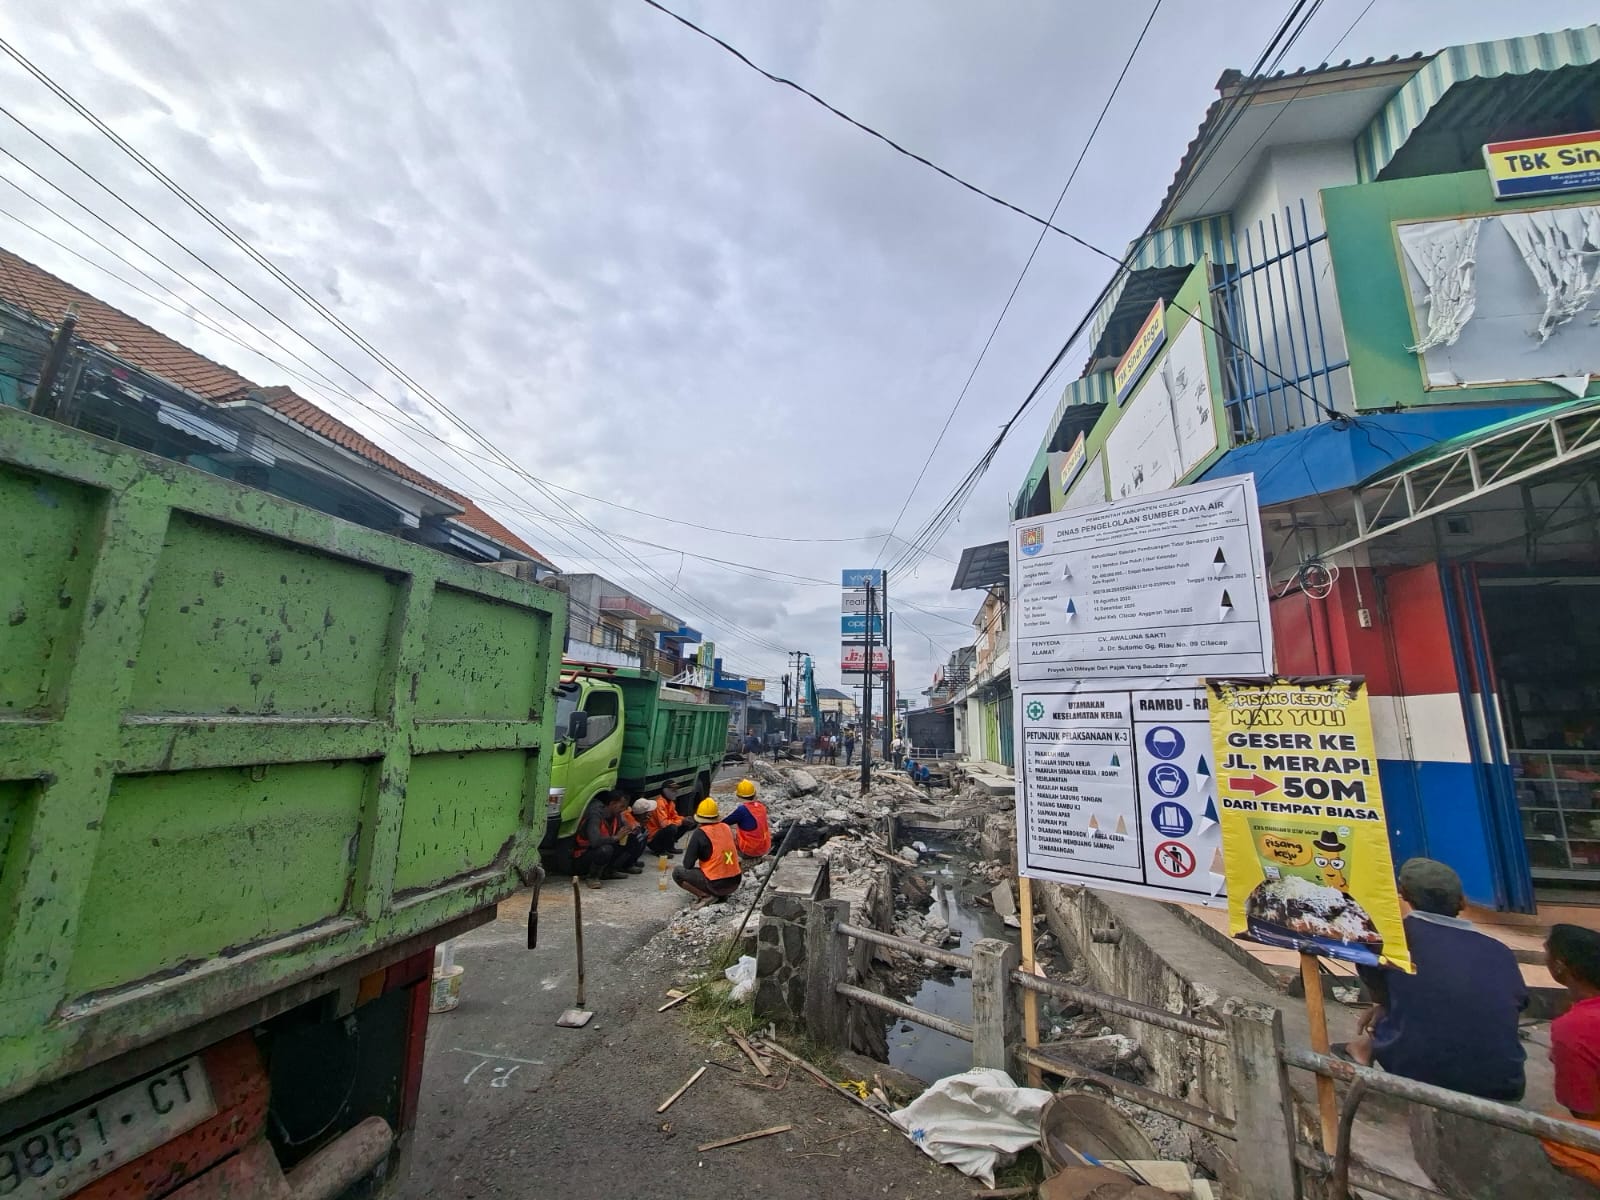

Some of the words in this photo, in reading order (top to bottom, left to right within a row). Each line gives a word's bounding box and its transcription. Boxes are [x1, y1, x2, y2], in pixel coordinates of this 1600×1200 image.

[1504, 153, 1550, 172] TBK
[1128, 344, 1144, 373] Sinar
[1143, 318, 1159, 348] Boga
[1086, 512, 1120, 523] PEMERINTAH
[1122, 506, 1158, 515] KABUPATEN
[1158, 500, 1187, 508] CILACAP
[1056, 527, 1080, 538] DINAS
[1081, 516, 1140, 532] PENGELOLAAN
[1142, 510, 1180, 522] SUMBER
[1182, 504, 1207, 514] DAYA
[1208, 501, 1225, 511] AIR
[1032, 640, 1060, 648] PENYEDIA
[1200, 640, 1228, 648] Cilacap
[1170, 662, 1188, 670] Bayar
[1068, 701, 1104, 710] UTAMAKAN
[1140, 698, 1182, 711] RAMBU
[1237, 692, 1289, 706] PISANG
[1290, 693, 1332, 706] KEJU
[1052, 712, 1099, 720] KESELAMATAN
[1100, 711, 1123, 719] KERJA
[1230, 709, 1283, 726] MAK
[1287, 709, 1346, 727] YULI
[1026, 732, 1060, 740] PETUNJUK
[1061, 732, 1113, 741] PELAKSANAAN
[1114, 733, 1127, 741] K-3
[1228, 732, 1313, 750] GESER
[1318, 734, 1356, 752] KE
[1222, 754, 1257, 770] JL.
[1263, 755, 1370, 776] MERAPI
[1284, 776, 1366, 803] 50M
[1060, 794, 1080, 802] SARUNG
[1080, 795, 1102, 803] TANGAN
[1223, 798, 1257, 810] DARI
[1260, 802, 1322, 816] TEMPAT
[1326, 806, 1380, 821] BIASA
[1063, 829, 1086, 838] MEROKOK
[1109, 834, 1124, 842] KERJA
[1038, 844, 1074, 854] SEMBARANGAN
[1063, 839, 1092, 847] MEMBUANG
[1093, 842, 1114, 850] SAMPAH
[147, 1063, 191, 1115] CT
